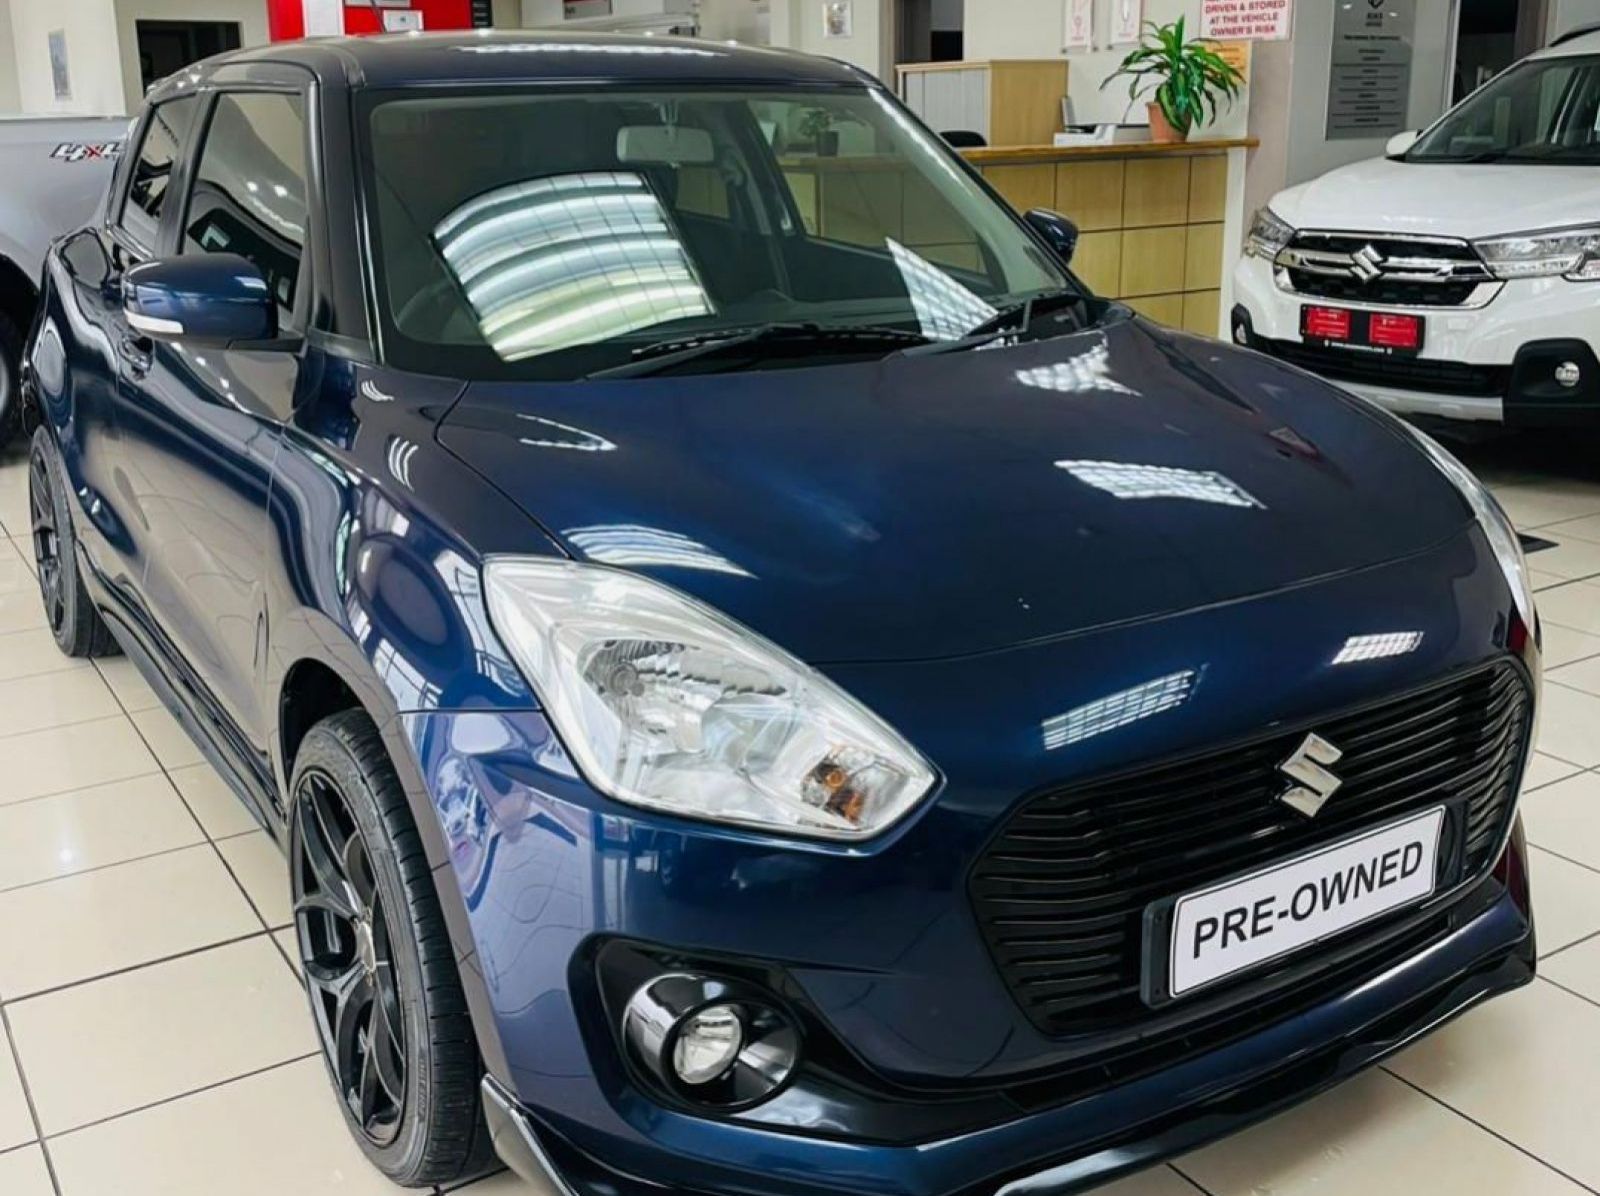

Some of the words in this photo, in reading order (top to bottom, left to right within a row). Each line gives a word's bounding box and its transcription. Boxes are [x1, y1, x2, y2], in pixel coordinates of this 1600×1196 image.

[1205, 3, 1237, 14] DRIVEN
[1239, 2, 1246, 11] &
[1248, 0, 1286, 11] STORED
[1210, 15, 1220, 24] AT
[1222, 14, 1238, 23] THE
[1241, 12, 1279, 23] VEHICLE
[1210, 25, 1252, 35] OWNER'S
[1254, 24, 1276, 33] RISK
[1193, 841, 1423, 959] PRE-OWNED
